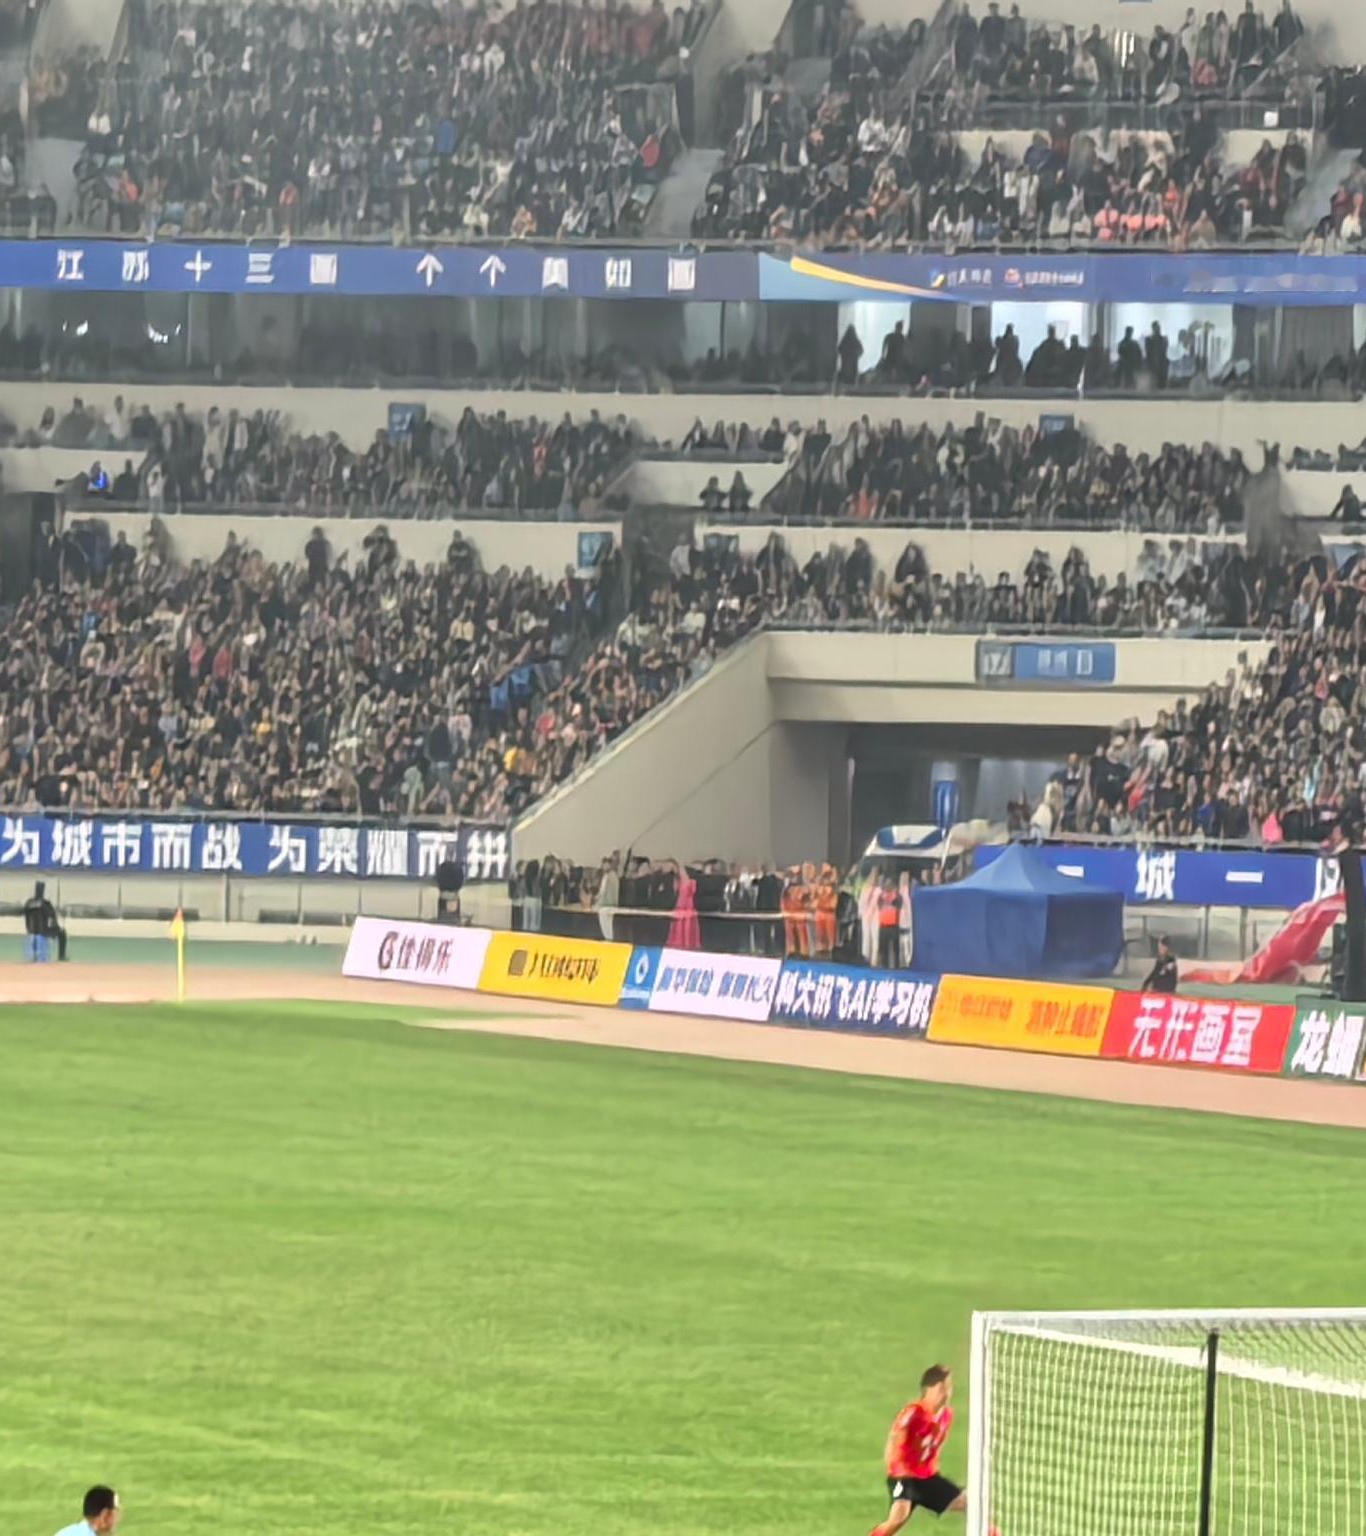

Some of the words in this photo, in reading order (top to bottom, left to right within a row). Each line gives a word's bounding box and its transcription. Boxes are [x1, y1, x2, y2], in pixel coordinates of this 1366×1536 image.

[0, 816, 243, 871] 为城市而战
[267, 824, 509, 880] 为荣耀而拼
